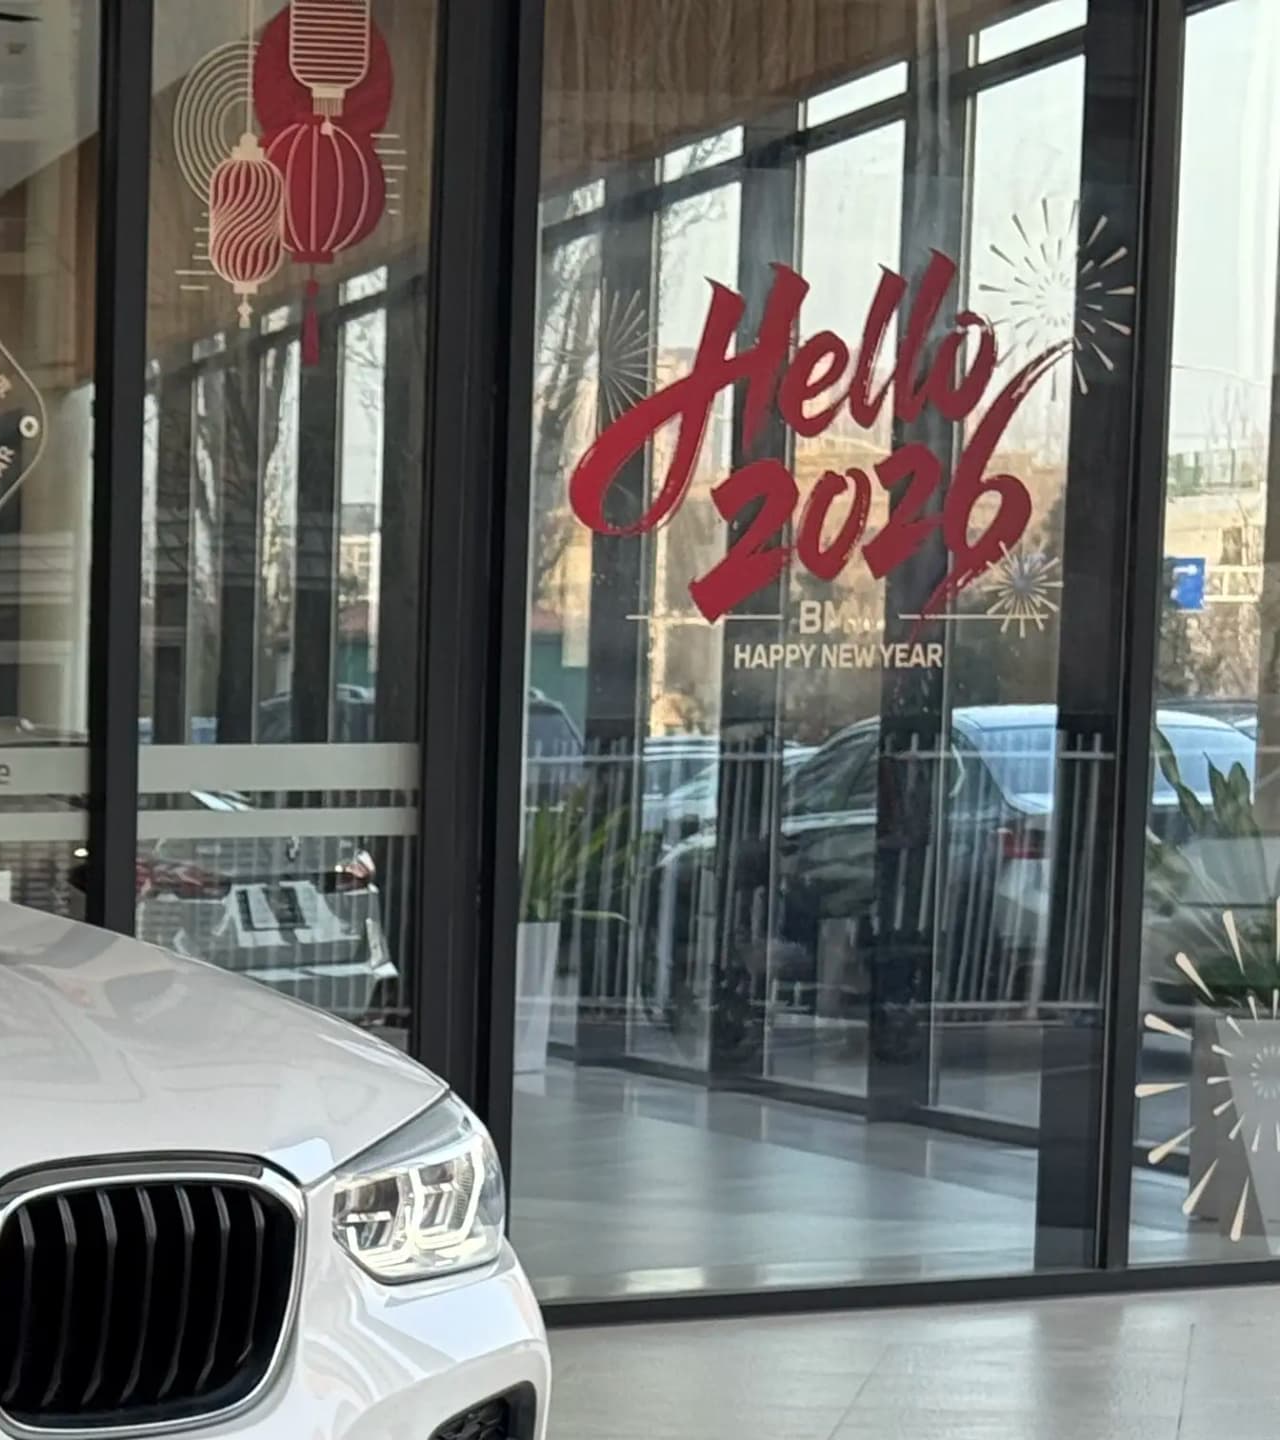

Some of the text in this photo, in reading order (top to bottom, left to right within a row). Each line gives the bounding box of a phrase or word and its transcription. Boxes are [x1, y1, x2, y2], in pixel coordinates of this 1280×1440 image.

[569, 248, 996, 535] Hello
[689, 337, 1074, 640] 2026
[734, 643, 943, 669] HAPPY NEW YEAR
